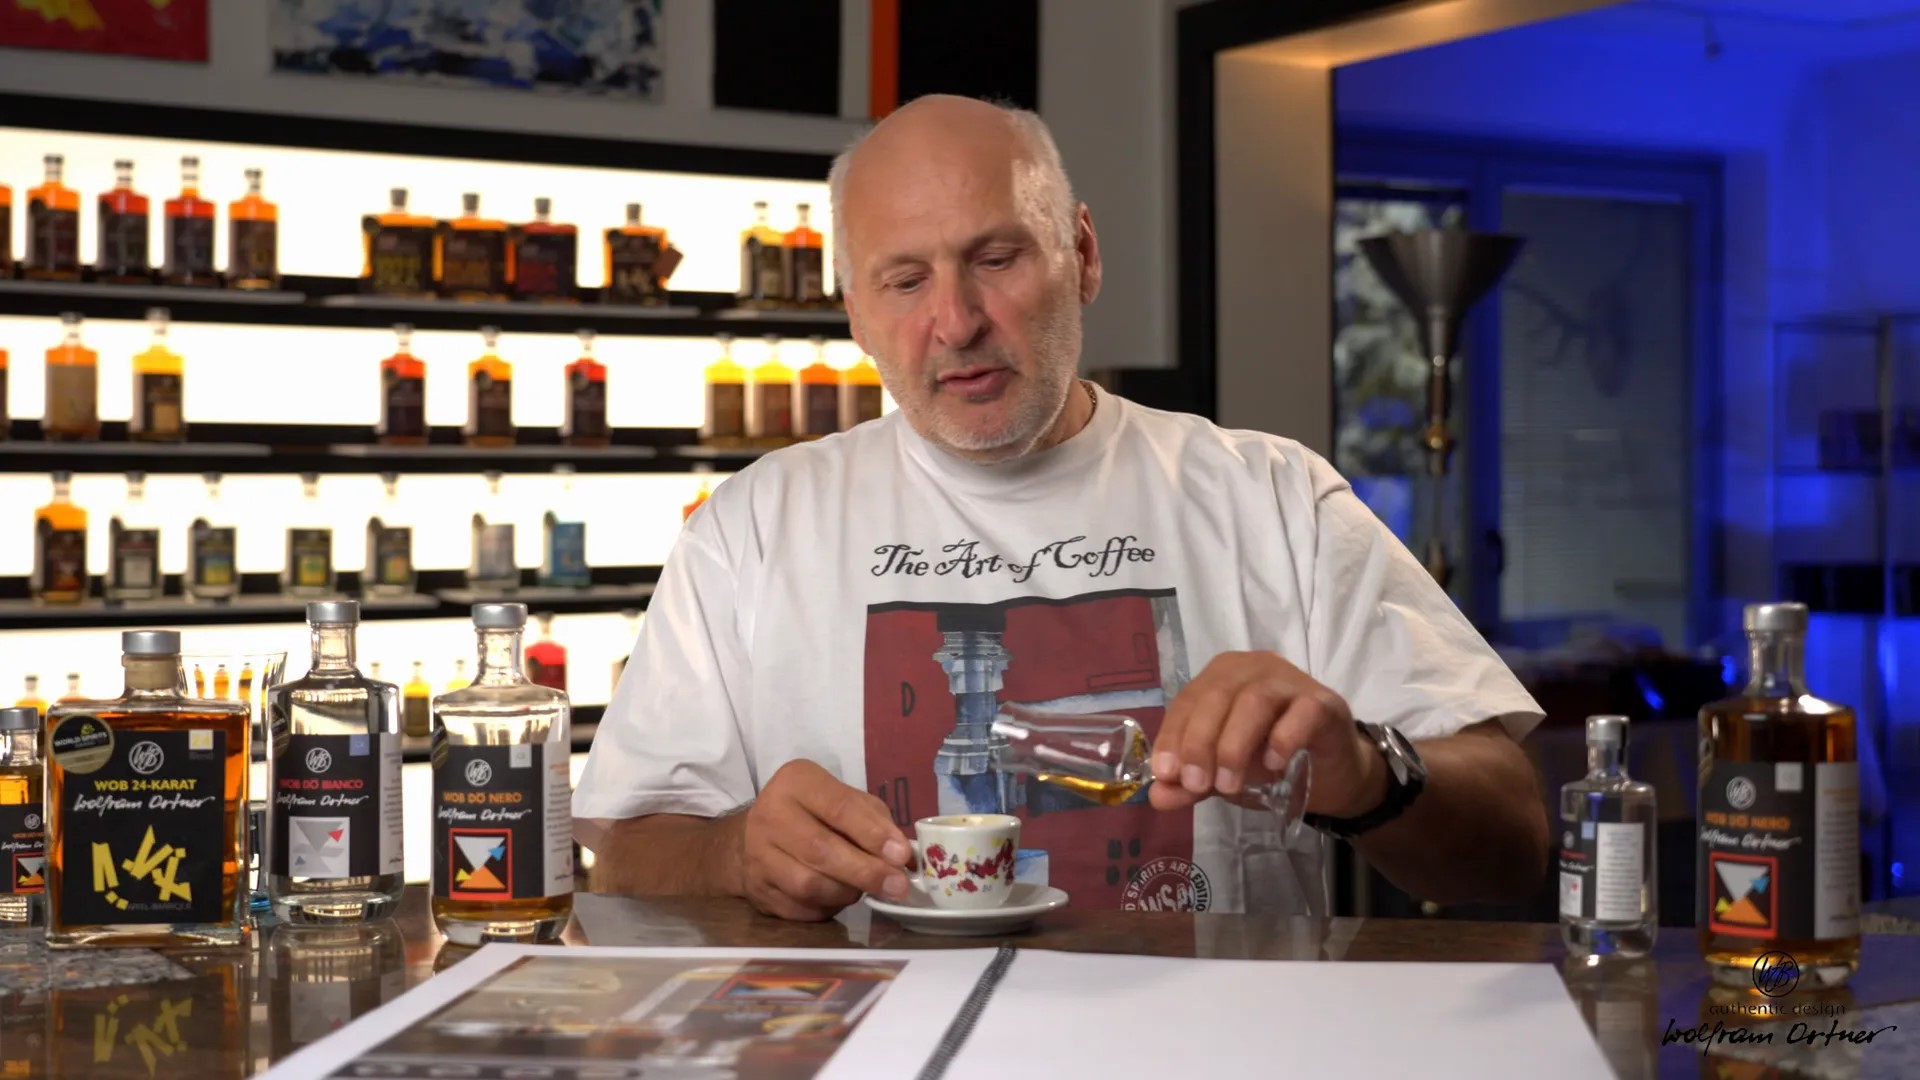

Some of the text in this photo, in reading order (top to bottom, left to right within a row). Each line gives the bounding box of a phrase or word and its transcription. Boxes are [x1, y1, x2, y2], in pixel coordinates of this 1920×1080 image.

[871, 535, 1156, 583] The Art of Coffee
[94, 778, 197, 791] WOB 24-KARAT
[322, 778, 364, 790] BIANCO
[148, 792, 217, 810] Ortner
[320, 793, 370, 807] Ortner
[443, 791, 465, 803] WOB
[489, 791, 522, 803] NERO
[480, 806, 533, 821] Ortner
[1127, 860, 1166, 899] SPIRITS
